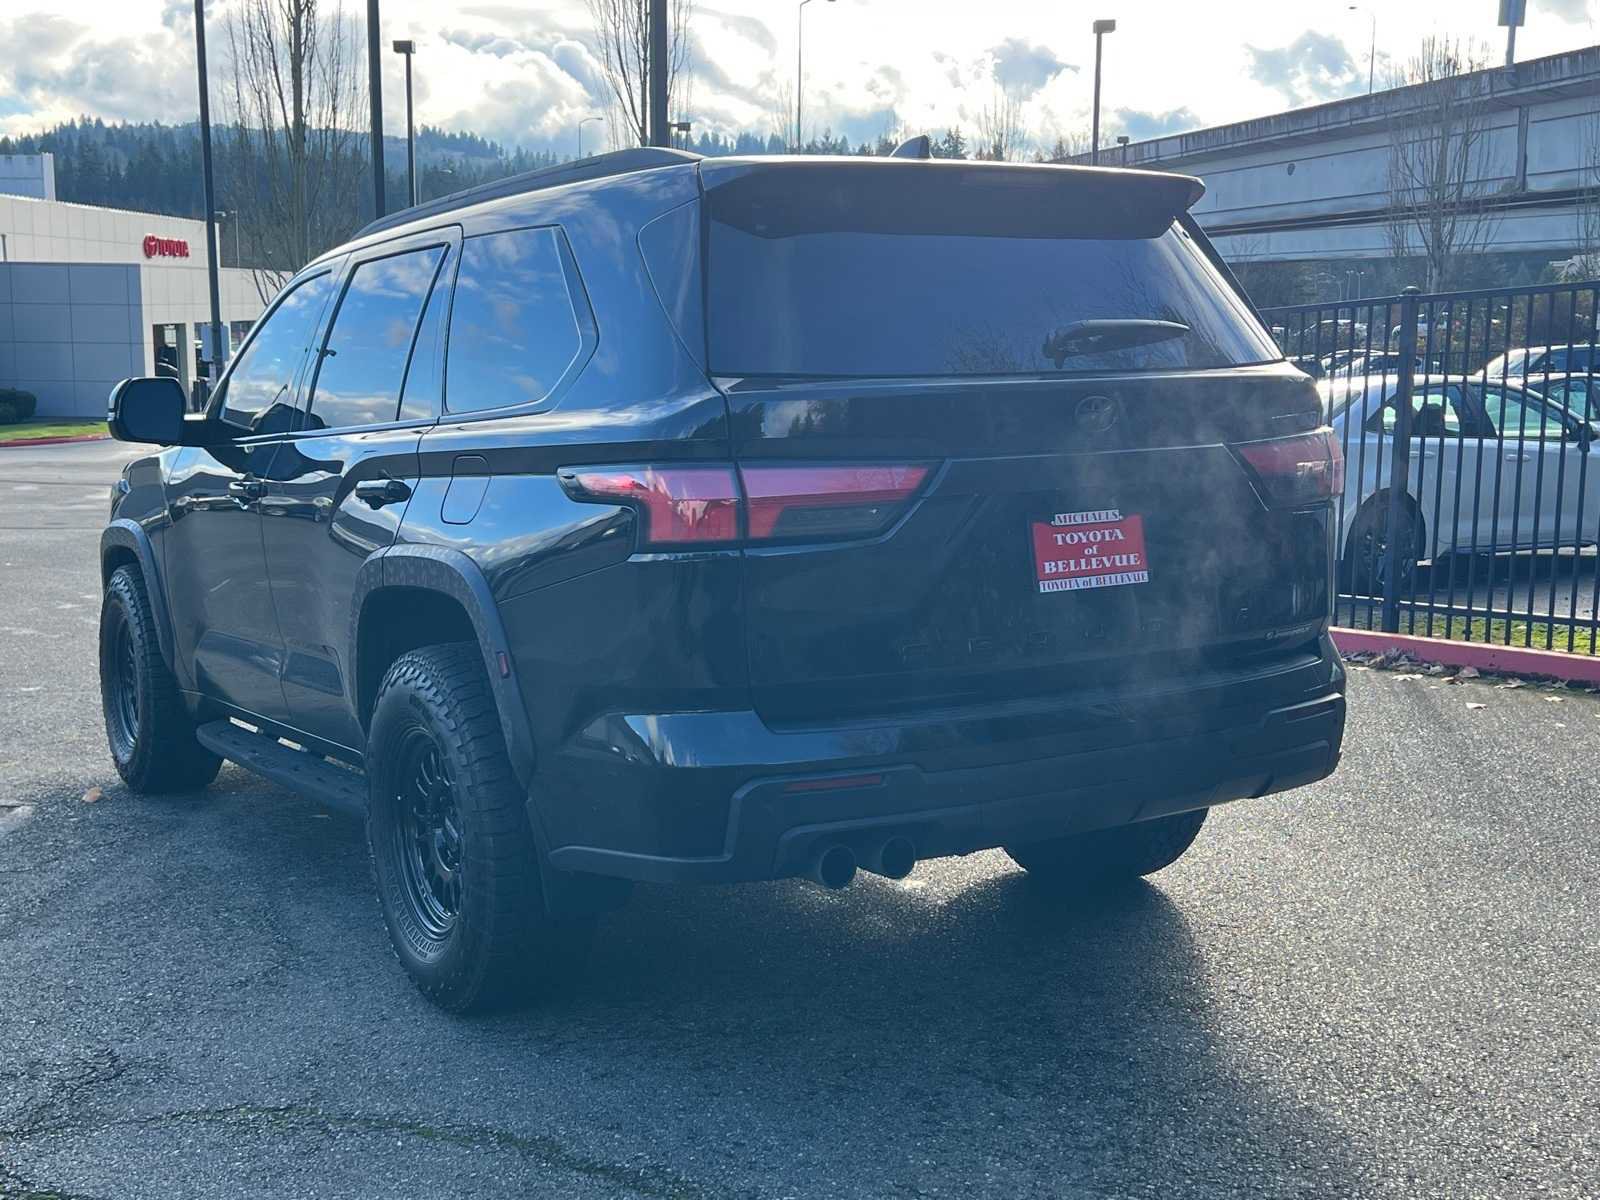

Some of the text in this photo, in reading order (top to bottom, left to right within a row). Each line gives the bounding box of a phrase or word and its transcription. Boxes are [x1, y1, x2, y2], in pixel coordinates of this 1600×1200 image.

[1054, 529, 1125, 545] TOYOTA
[1084, 545, 1098, 555] of
[1044, 553, 1141, 574] BELLEVUE
[1041, 572, 1146, 591] TOYOTA of BELLEVUE
